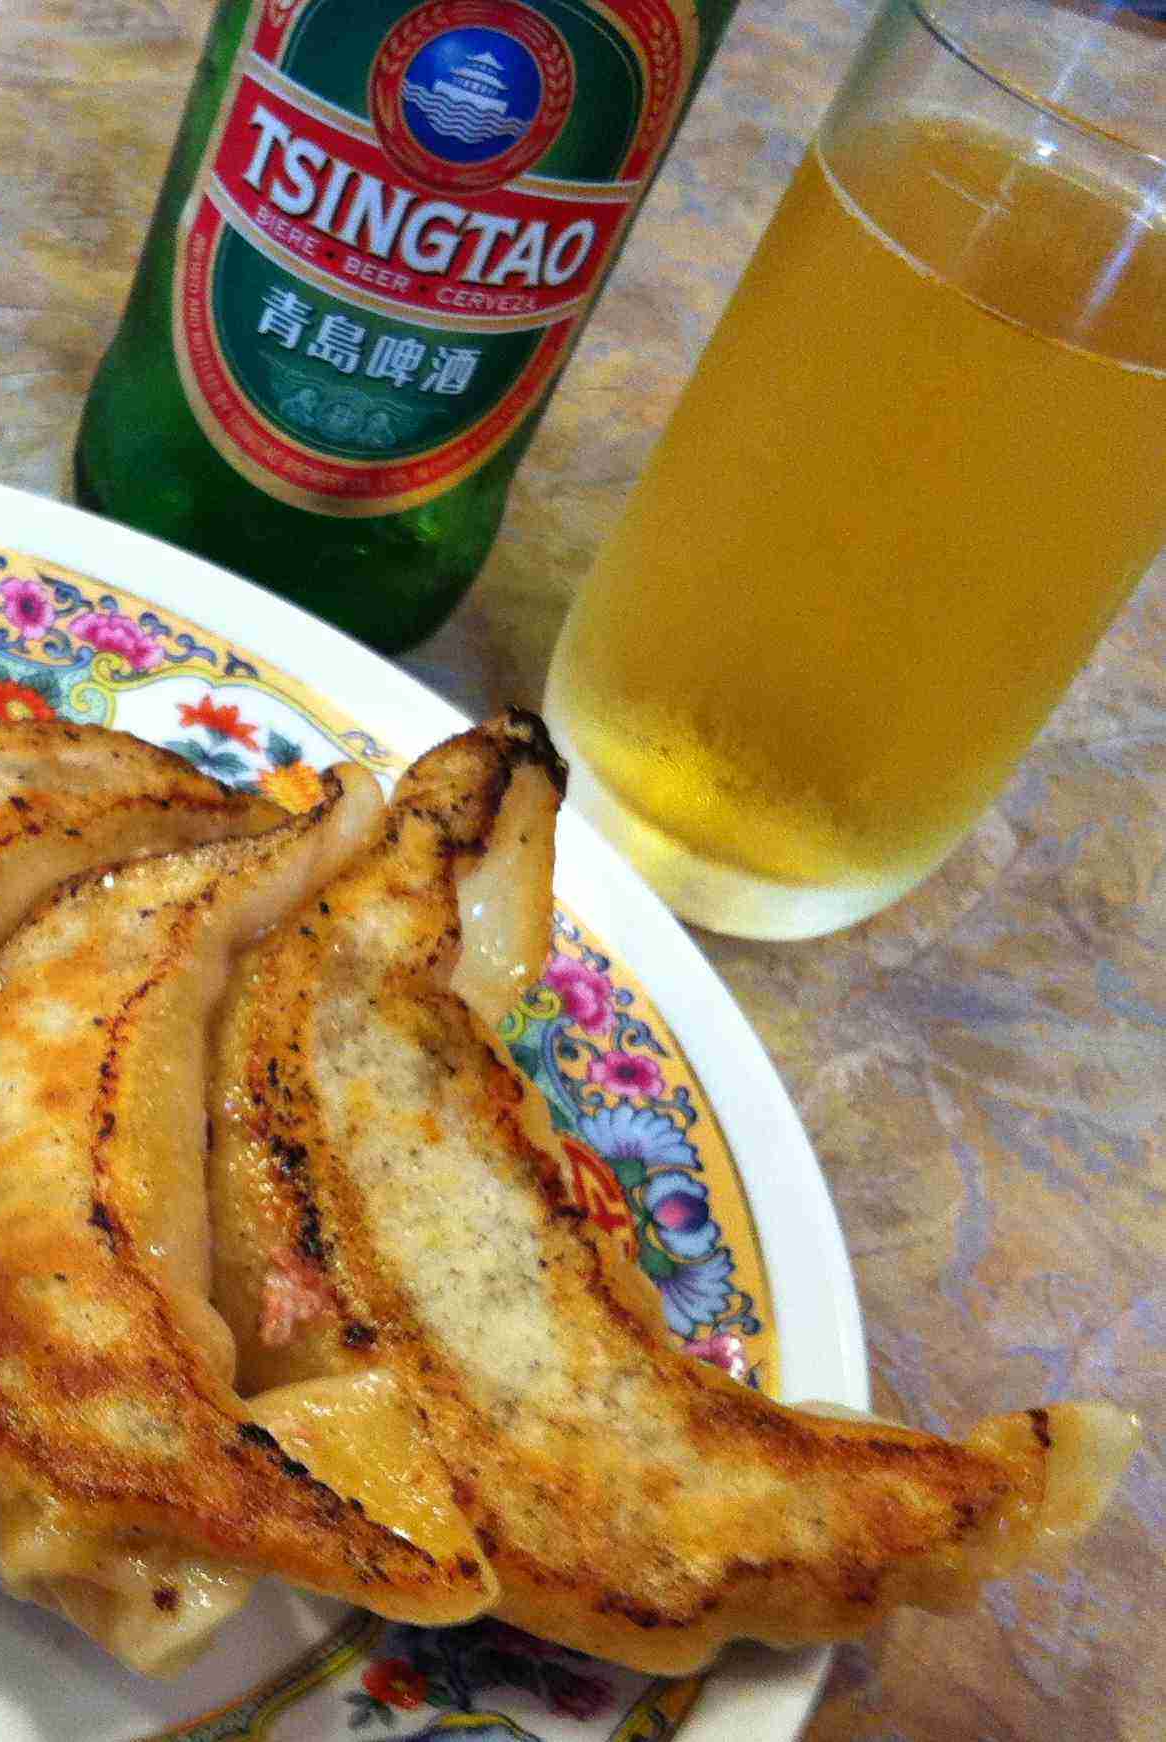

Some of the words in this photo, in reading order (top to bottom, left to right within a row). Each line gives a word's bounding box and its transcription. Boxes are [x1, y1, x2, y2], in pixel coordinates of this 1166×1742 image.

[242, 104, 596, 287] TSINGTAO
[343, 254, 412, 293] BEER
[257, 285, 483, 395] 青島啤酒
